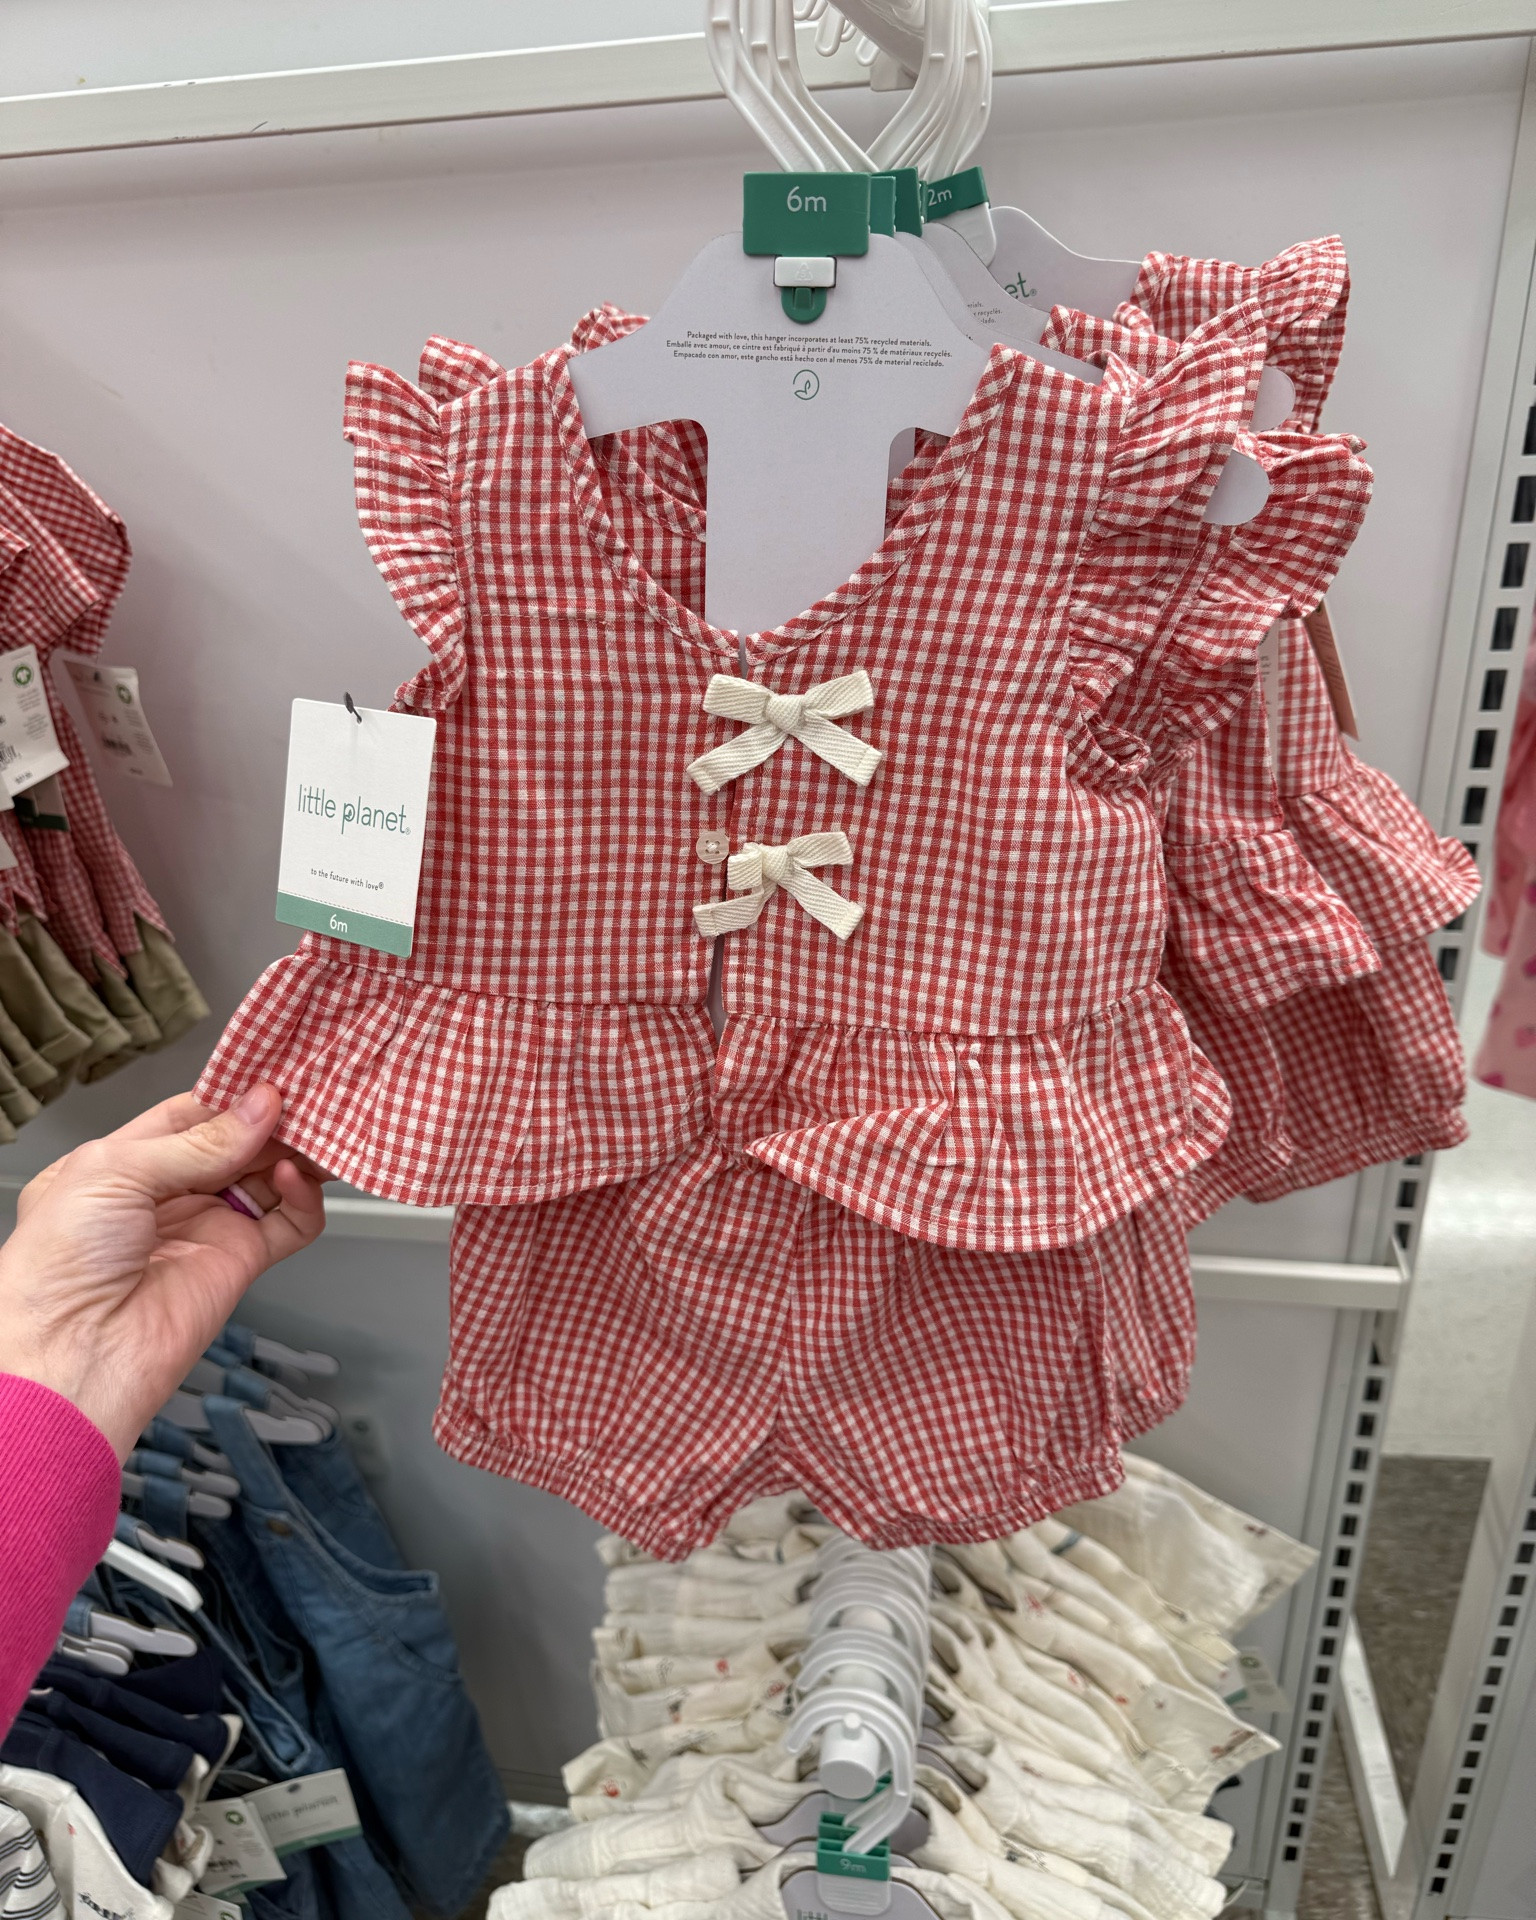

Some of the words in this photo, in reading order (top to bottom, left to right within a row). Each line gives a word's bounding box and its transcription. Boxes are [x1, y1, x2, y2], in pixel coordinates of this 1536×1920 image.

[787, 186, 827, 212] 6m
[927, 189, 953, 207] 2m
[687, 331, 717, 341] Packaged
[719, 332, 732, 340] with
[734, 333, 749, 341] love,
[764, 334, 786, 343] hanger
[788, 335, 828, 345] incorporates
[838, 336, 854, 344] least
[855, 337, 869, 345] 75%
[870, 337, 898, 347] recycled
[900, 339, 931, 347] materials.
[666, 340, 692, 348] Emballé
[742, 343, 761, 351] cintre
[773, 343, 800, 354] fabriqué
[807, 345, 825, 354] partir
[827, 345, 840, 353] d'au
[862, 347, 871, 355] 75
[872, 347, 878, 355] %
[880, 347, 888, 355] de
[890, 348, 922, 356] matériaux
[923, 349, 952, 359] recyclés.
[673, 350, 706, 359] Empacado
[756, 354, 778, 363] gancho
[780, 354, 793, 362] está
[795, 354, 814, 362] hecho
[874, 357, 882, 365] de
[884, 358, 911, 366] material
[298, 784, 336, 818] little
[318, 869, 328, 878] the
[329, 871, 349, 884] future
[350, 877, 364, 887] with
[329, 914, 348, 933] 6m
